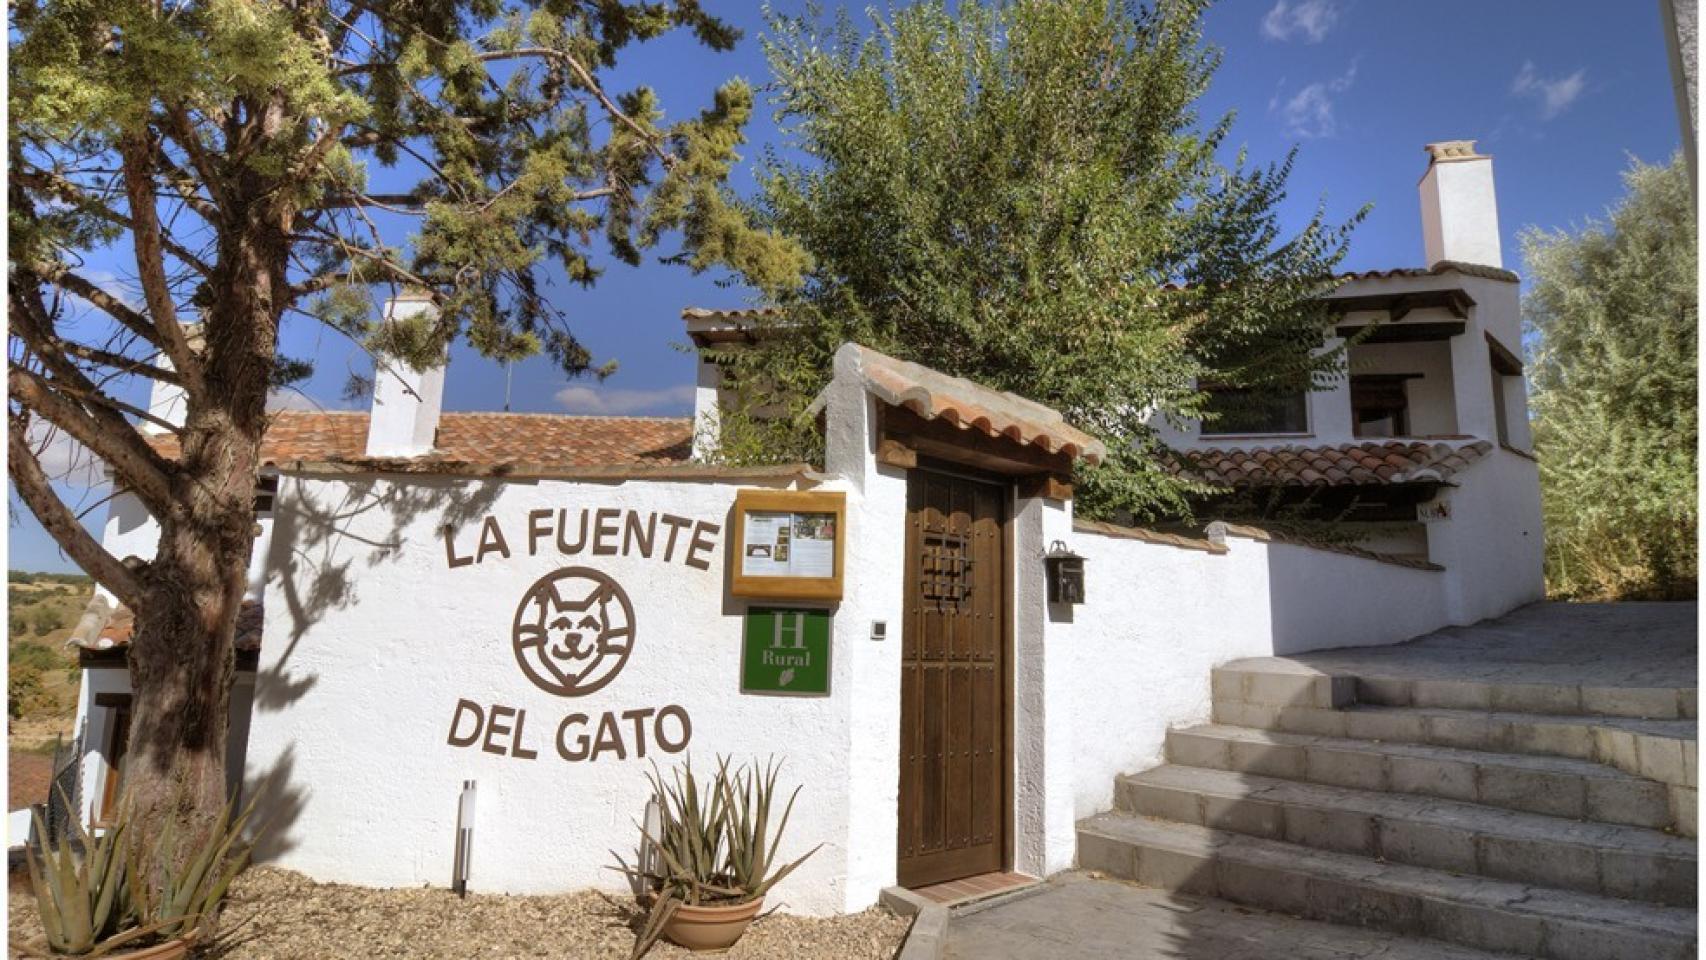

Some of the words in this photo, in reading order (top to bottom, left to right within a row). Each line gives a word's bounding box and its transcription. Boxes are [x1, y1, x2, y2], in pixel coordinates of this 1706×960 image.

[444, 515, 511, 569] LA
[528, 507, 721, 571] FUENTE
[769, 611, 809, 649] H
[762, 649, 811, 667] Rural
[446, 697, 538, 760] DEL
[556, 704, 693, 762] GATO
